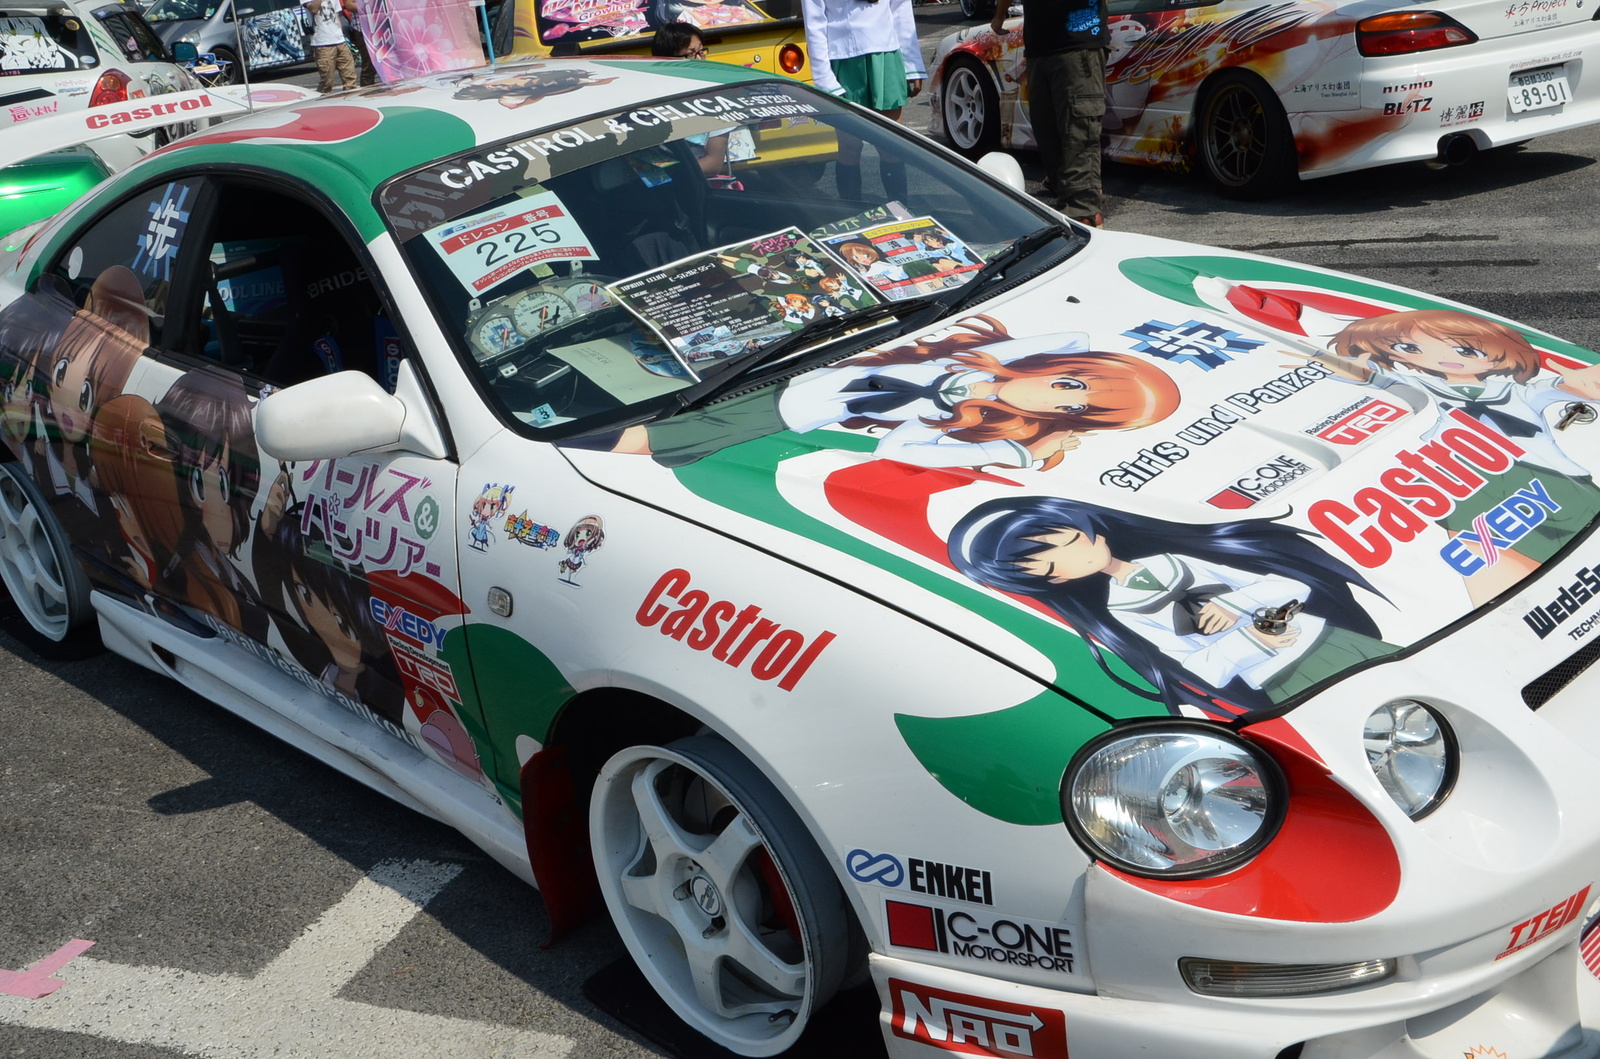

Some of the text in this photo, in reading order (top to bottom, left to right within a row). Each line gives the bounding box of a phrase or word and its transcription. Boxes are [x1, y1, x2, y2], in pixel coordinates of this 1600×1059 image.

[736, 94, 797, 107] E-ST202
[1382, 80, 1433, 94] nismo
[1521, 82, 1567, 107] 89-01
[85, 94, 213, 130] Castrol
[750, 103, 820, 118] GARUPAN
[439, 95, 745, 189] CASTROL & CELICA
[457, 222, 510, 246] ドレコン
[522, 209, 550, 225] 番号
[475, 222, 562, 268] 225
[1099, 360, 1336, 492] Girls und Panzer
[1304, 395, 1374, 436] Racing Development
[1324, 403, 1400, 445] TRD
[1255, 463, 1315, 501] MOTORSPORT
[1307, 408, 1527, 569] Castrol
[301, 493, 441, 578] パンツァー
[1439, 478, 1562, 578] EXEDY
[369, 596, 448, 652] EXEDY
[635, 568, 838, 693] Castrol
[396, 652, 456, 695] TRD
[907, 857, 994, 906] ENKEI
[952, 940, 1074, 973] MOTORSPORT
[899, 989, 1035, 1057] NAO
